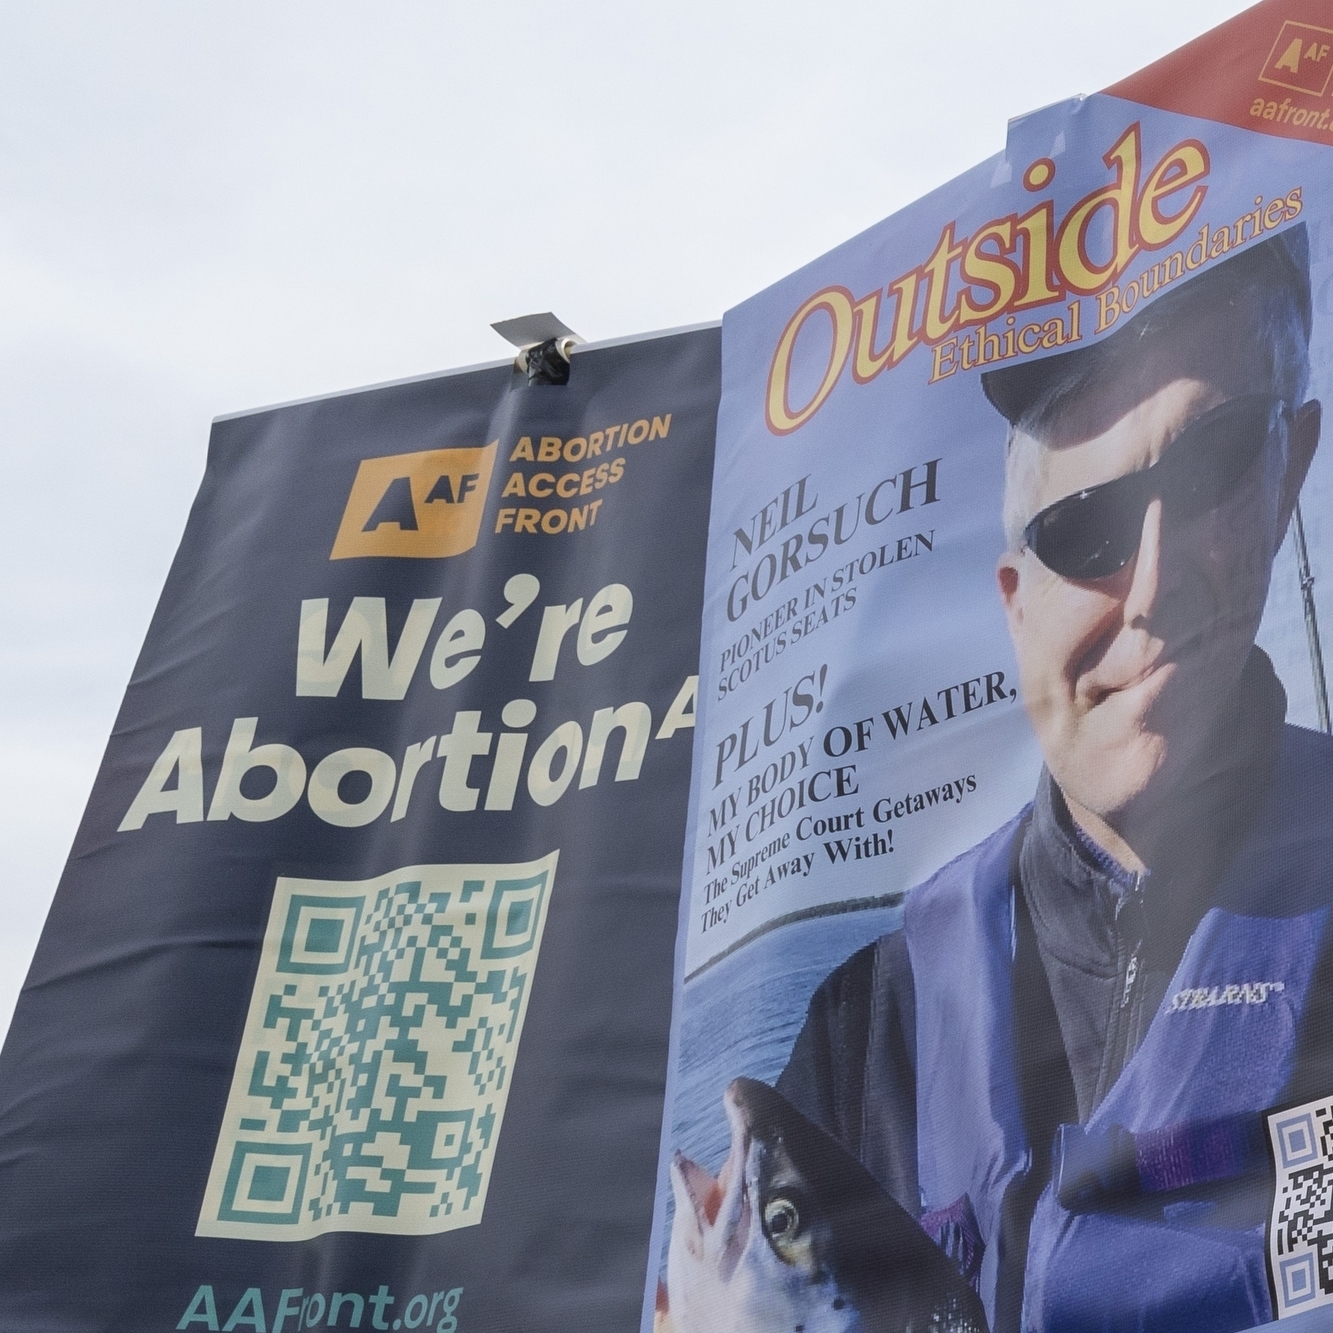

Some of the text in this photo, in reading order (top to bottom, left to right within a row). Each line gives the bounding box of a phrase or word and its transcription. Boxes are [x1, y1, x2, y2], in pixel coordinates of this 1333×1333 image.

[764, 121, 1211, 438] Outside
[927, 302, 1083, 387] Ethical
[1093, 186, 1305, 337] Boundaries
[502, 458, 626, 498] ACCESS
[510, 414, 671, 462] ABORTION
[495, 500, 602, 534] FRONT
[726, 458, 943, 623] GORSUCH
[729, 473, 818, 572] NEIL
[717, 587, 858, 701] SCOTUS SEATS
[720, 529, 936, 673] PIONEER IN STOLEN
[707, 670, 1018, 838] MY BODY OF WATER,
[711, 664, 828, 790] PLUS!
[704, 774, 977, 905] The Supreme Court Getaways
[705, 765, 860, 875] MY CHOICE
[701, 829, 895, 933] They Get Away With!
